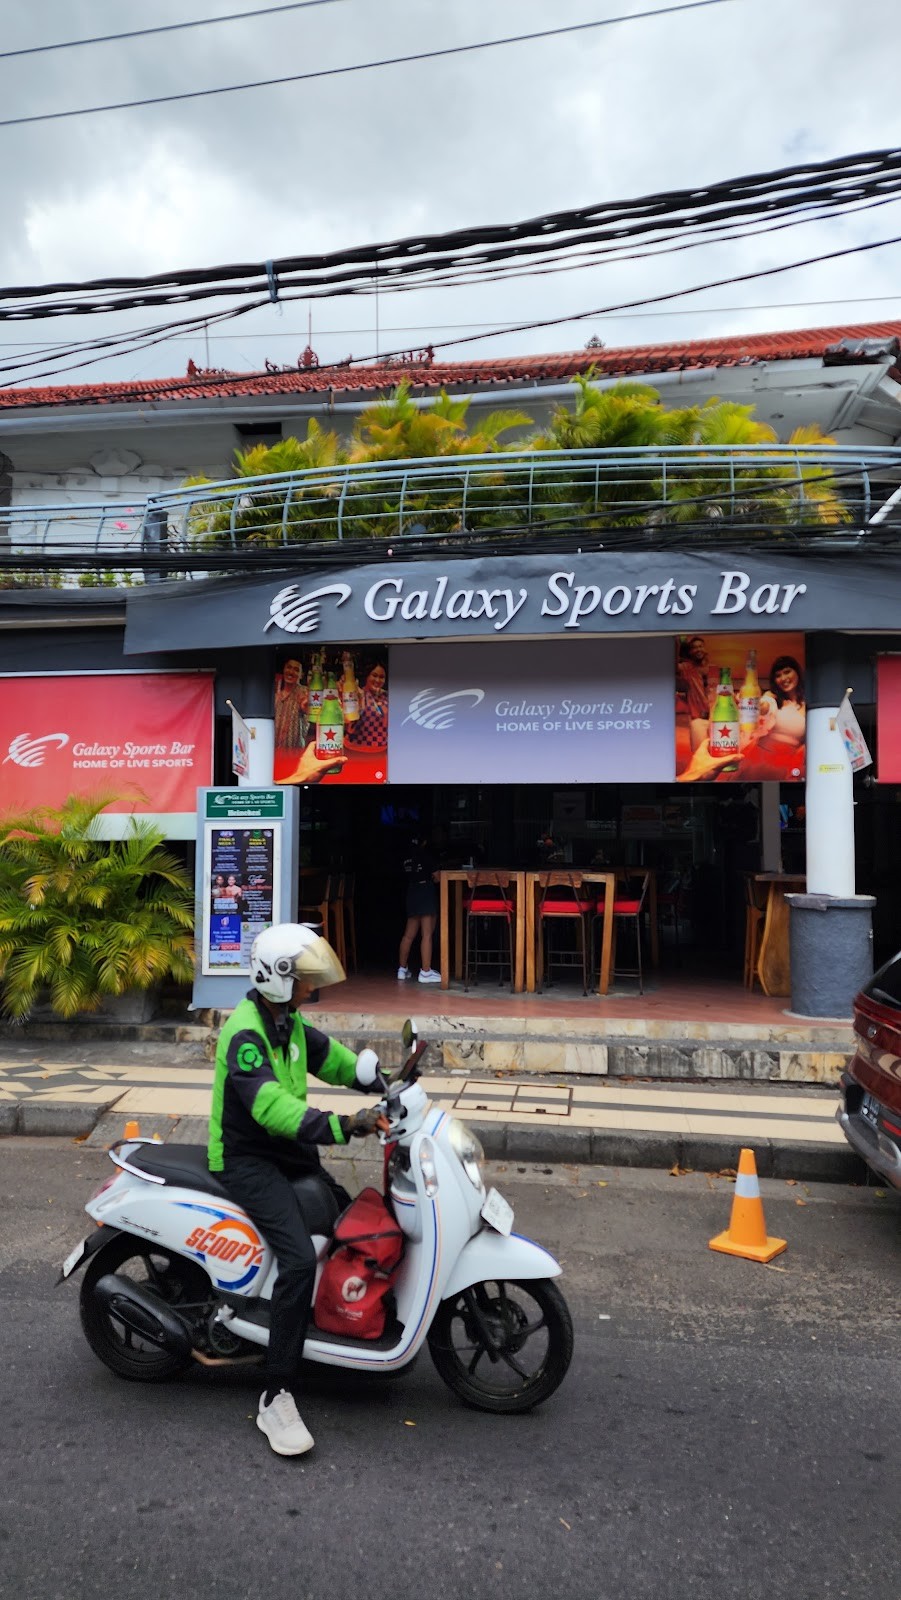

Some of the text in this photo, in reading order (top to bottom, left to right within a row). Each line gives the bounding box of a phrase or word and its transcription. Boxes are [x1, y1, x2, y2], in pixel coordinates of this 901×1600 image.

[364, 571, 807, 631] Galaxy Sports Bar
[495, 698, 653, 720] Galaxy Sports Bar
[496, 719, 651, 732] HOME OF LIVE SPORTS
[72, 741, 195, 759] Galaxy Sports Bar
[73, 758, 194, 769] HOME OF LIVE SPORTS
[227, 809, 262, 817] Heineken
[184, 1227, 265, 1268] SCOOPY
